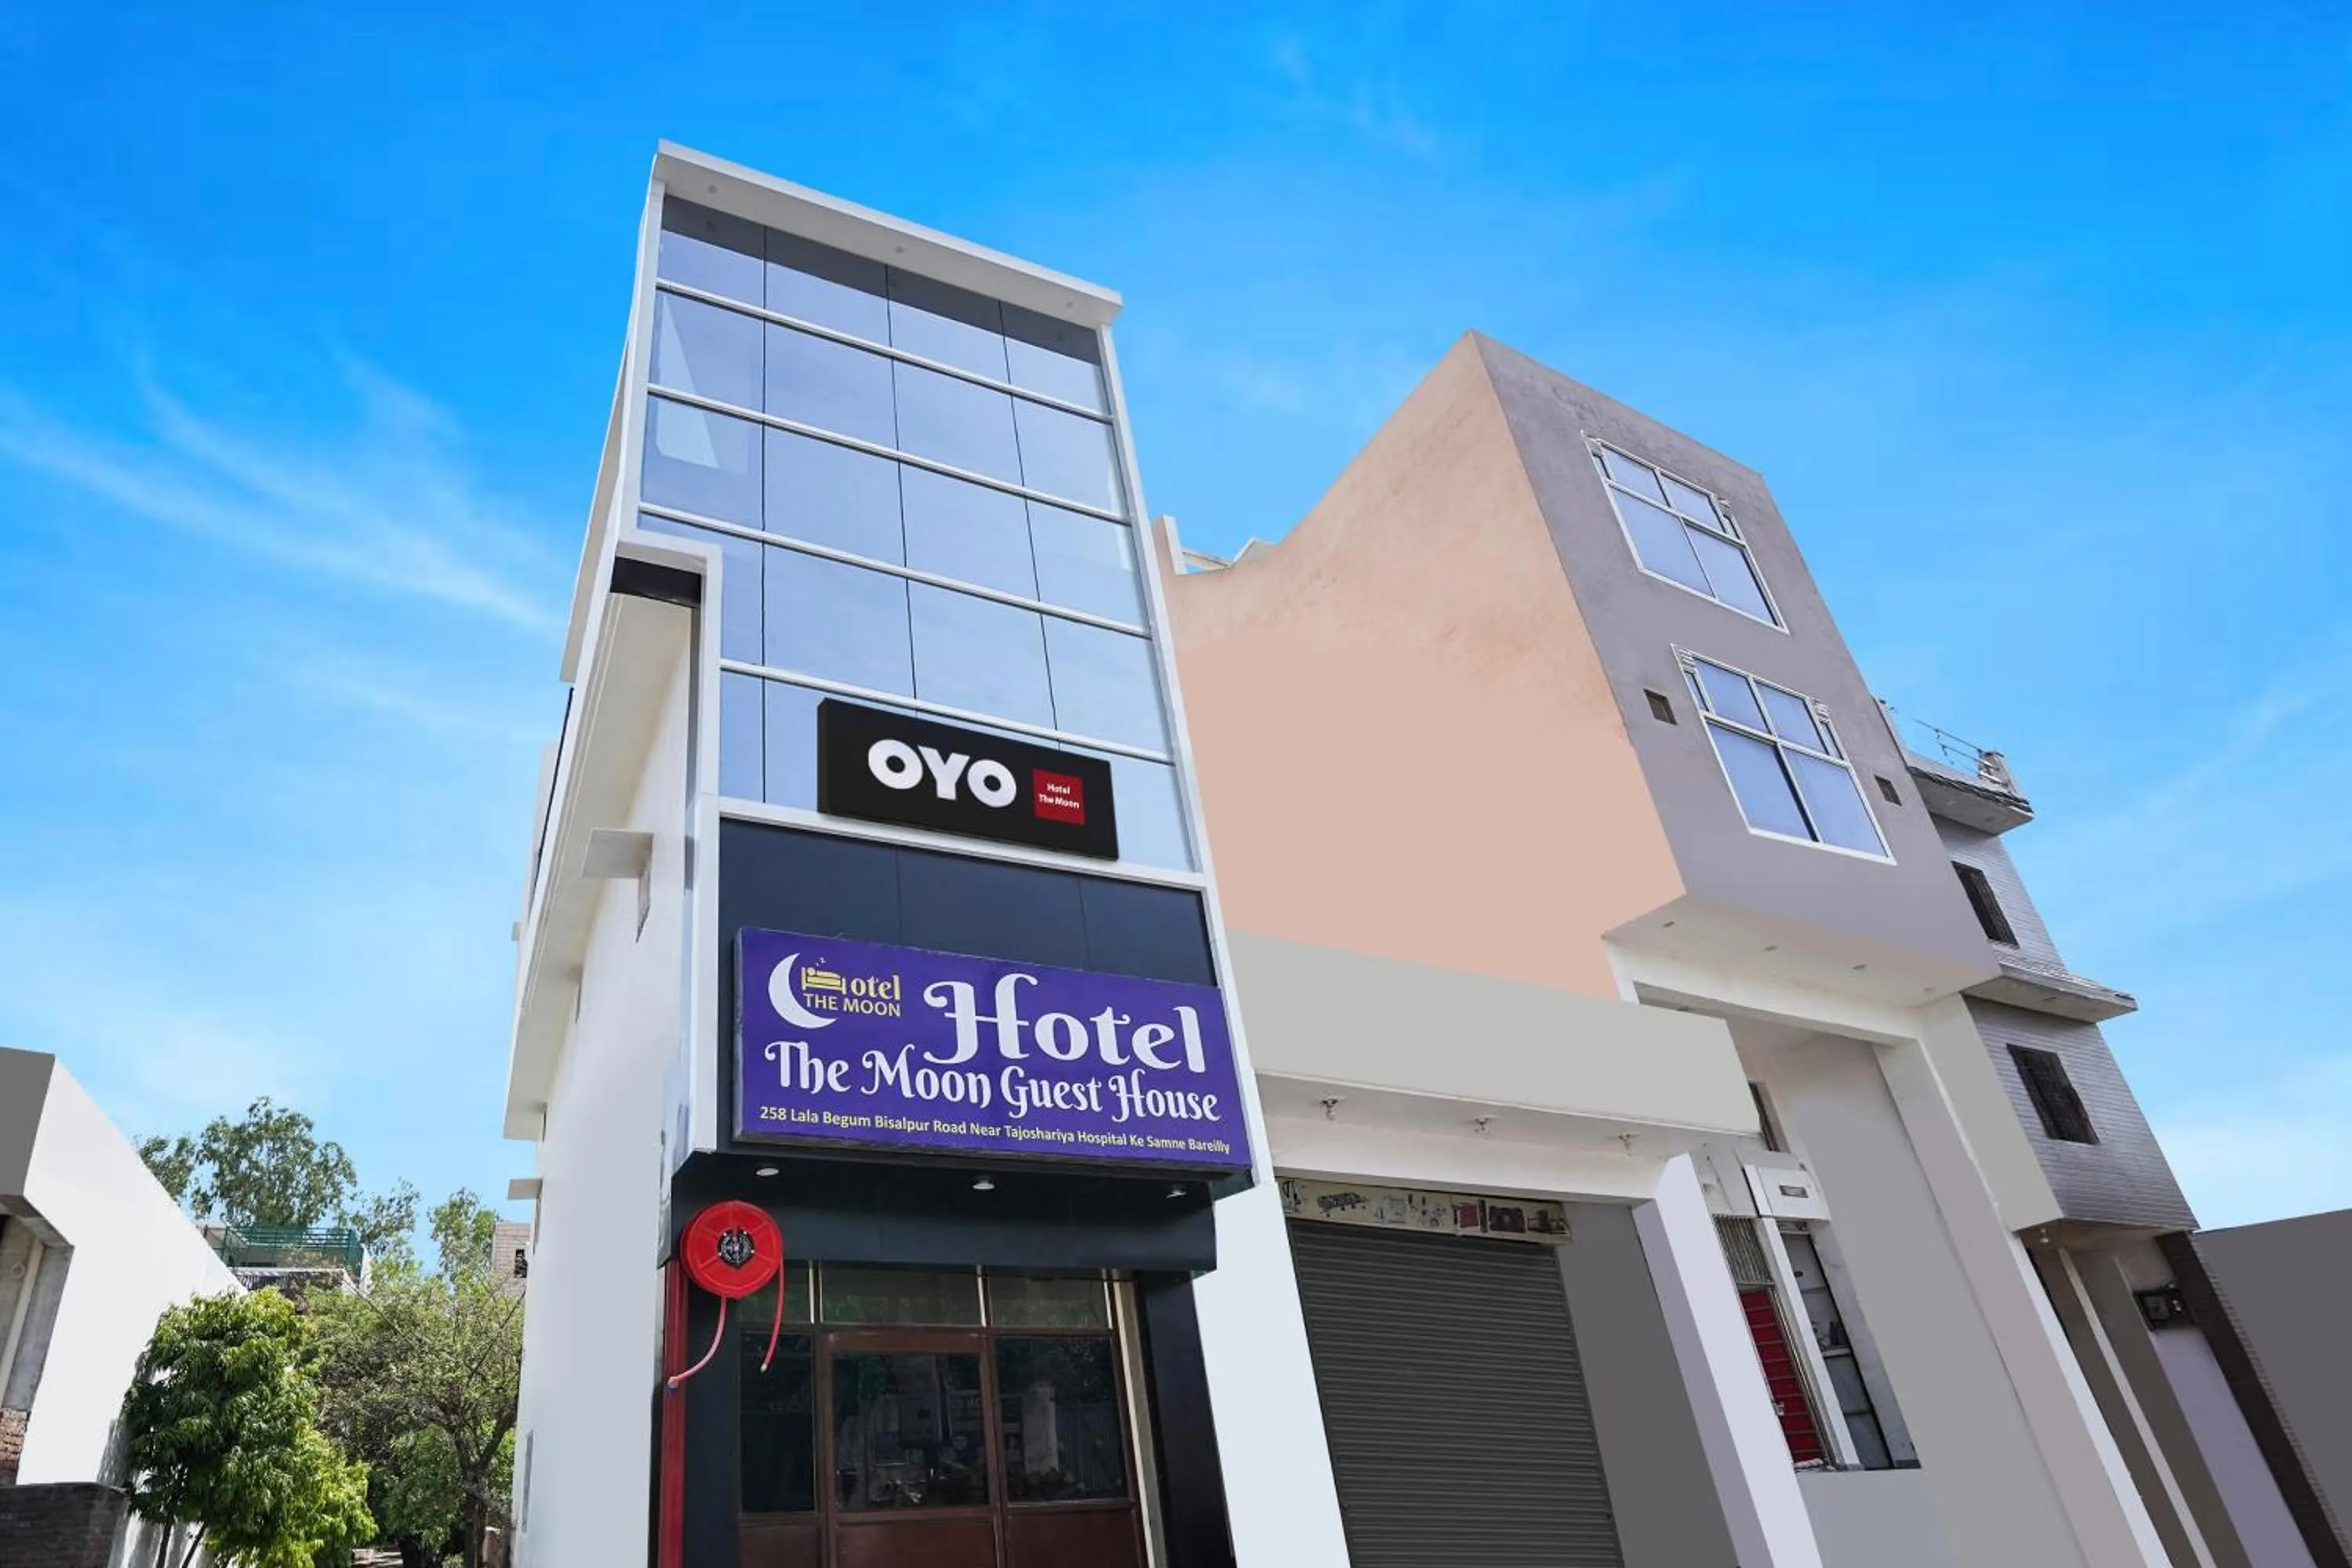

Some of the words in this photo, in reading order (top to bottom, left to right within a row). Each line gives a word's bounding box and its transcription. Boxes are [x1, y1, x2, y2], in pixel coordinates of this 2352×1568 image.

[868, 739, 1017, 808] OYO
[1047, 783, 1070, 794] Hotel
[1054, 797, 1080, 808] Moon
[803, 993, 838, 1010] THE
[843, 998, 901, 1017] MOON
[923, 973, 1207, 1073] Hotel
[764, 1041, 851, 1094] The
[861, 1044, 992, 1108] Moon
[1000, 1065, 1102, 1119] Guest
[1108, 1069, 1221, 1122] House
[760, 1106, 786, 1120] 258
[790, 1109, 818, 1123] Lala
[823, 1111, 871, 1128] Begum
[874, 1116, 930, 1133] Bisalpur
[934, 1120, 967, 1134] Road
[970, 1123, 1001, 1137] Near
[1004, 1125, 1075, 1144] Tajoshariya
[1077, 1131, 1127, 1146] Hospital
[1130, 1134, 1145, 1147] Ke
[1147, 1136, 1185, 1150] Samne
[1189, 1138, 1230, 1155] Bareilly
